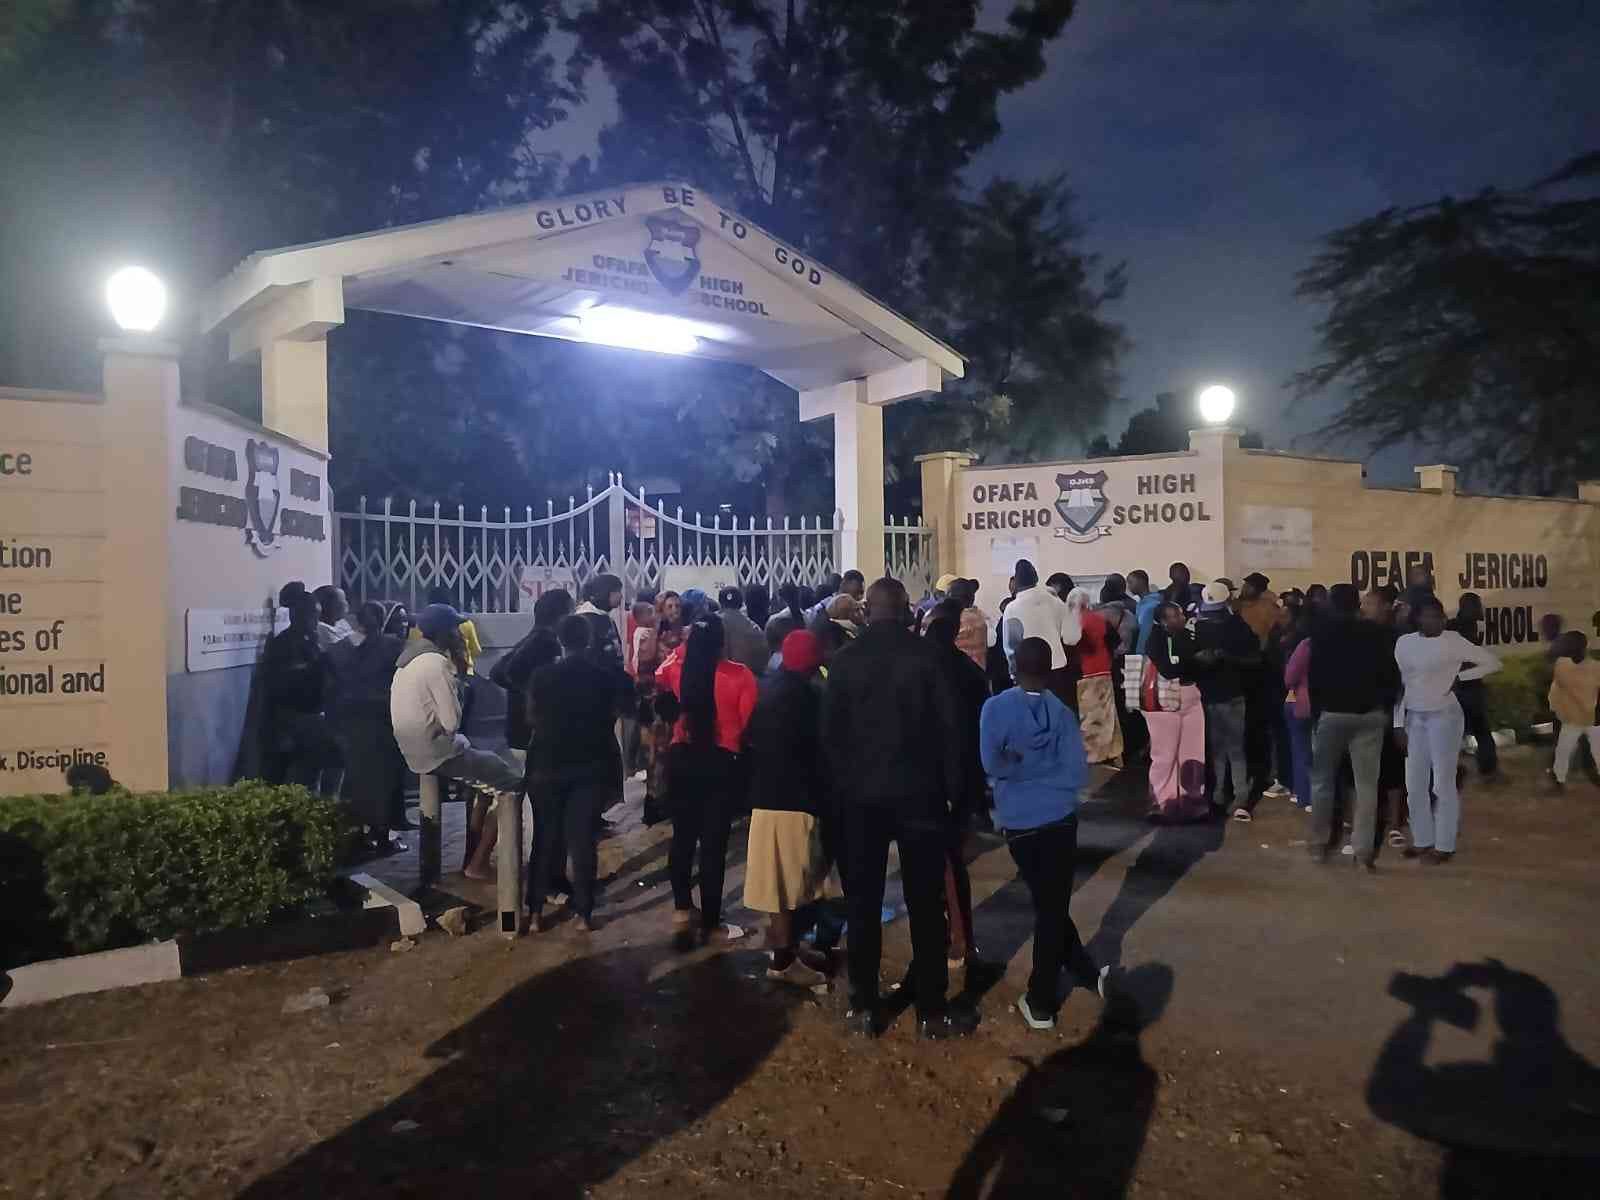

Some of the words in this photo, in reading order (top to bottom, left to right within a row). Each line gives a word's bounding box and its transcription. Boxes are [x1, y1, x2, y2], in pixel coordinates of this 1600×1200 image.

[536, 196, 627, 231] GLORY
[663, 185, 696, 208] BE
[718, 210, 748, 240] TO
[774, 246, 823, 286] GOD
[592, 253, 648, 277] OFAFA
[700, 275, 744, 296] HIGH
[697, 291, 770, 317] SCHOOL
[972, 481, 1039, 504] OFAFA
[1136, 473, 1196, 496] HIGH
[961, 508, 1052, 531] JERICHO
[1112, 500, 1211, 526] SCHOOL
[1458, 552, 1548, 589] JERICHO
[35, 620, 65, 651] of
[1473, 605, 1539, 646] CHOOL
[61, 663, 105, 693] and
